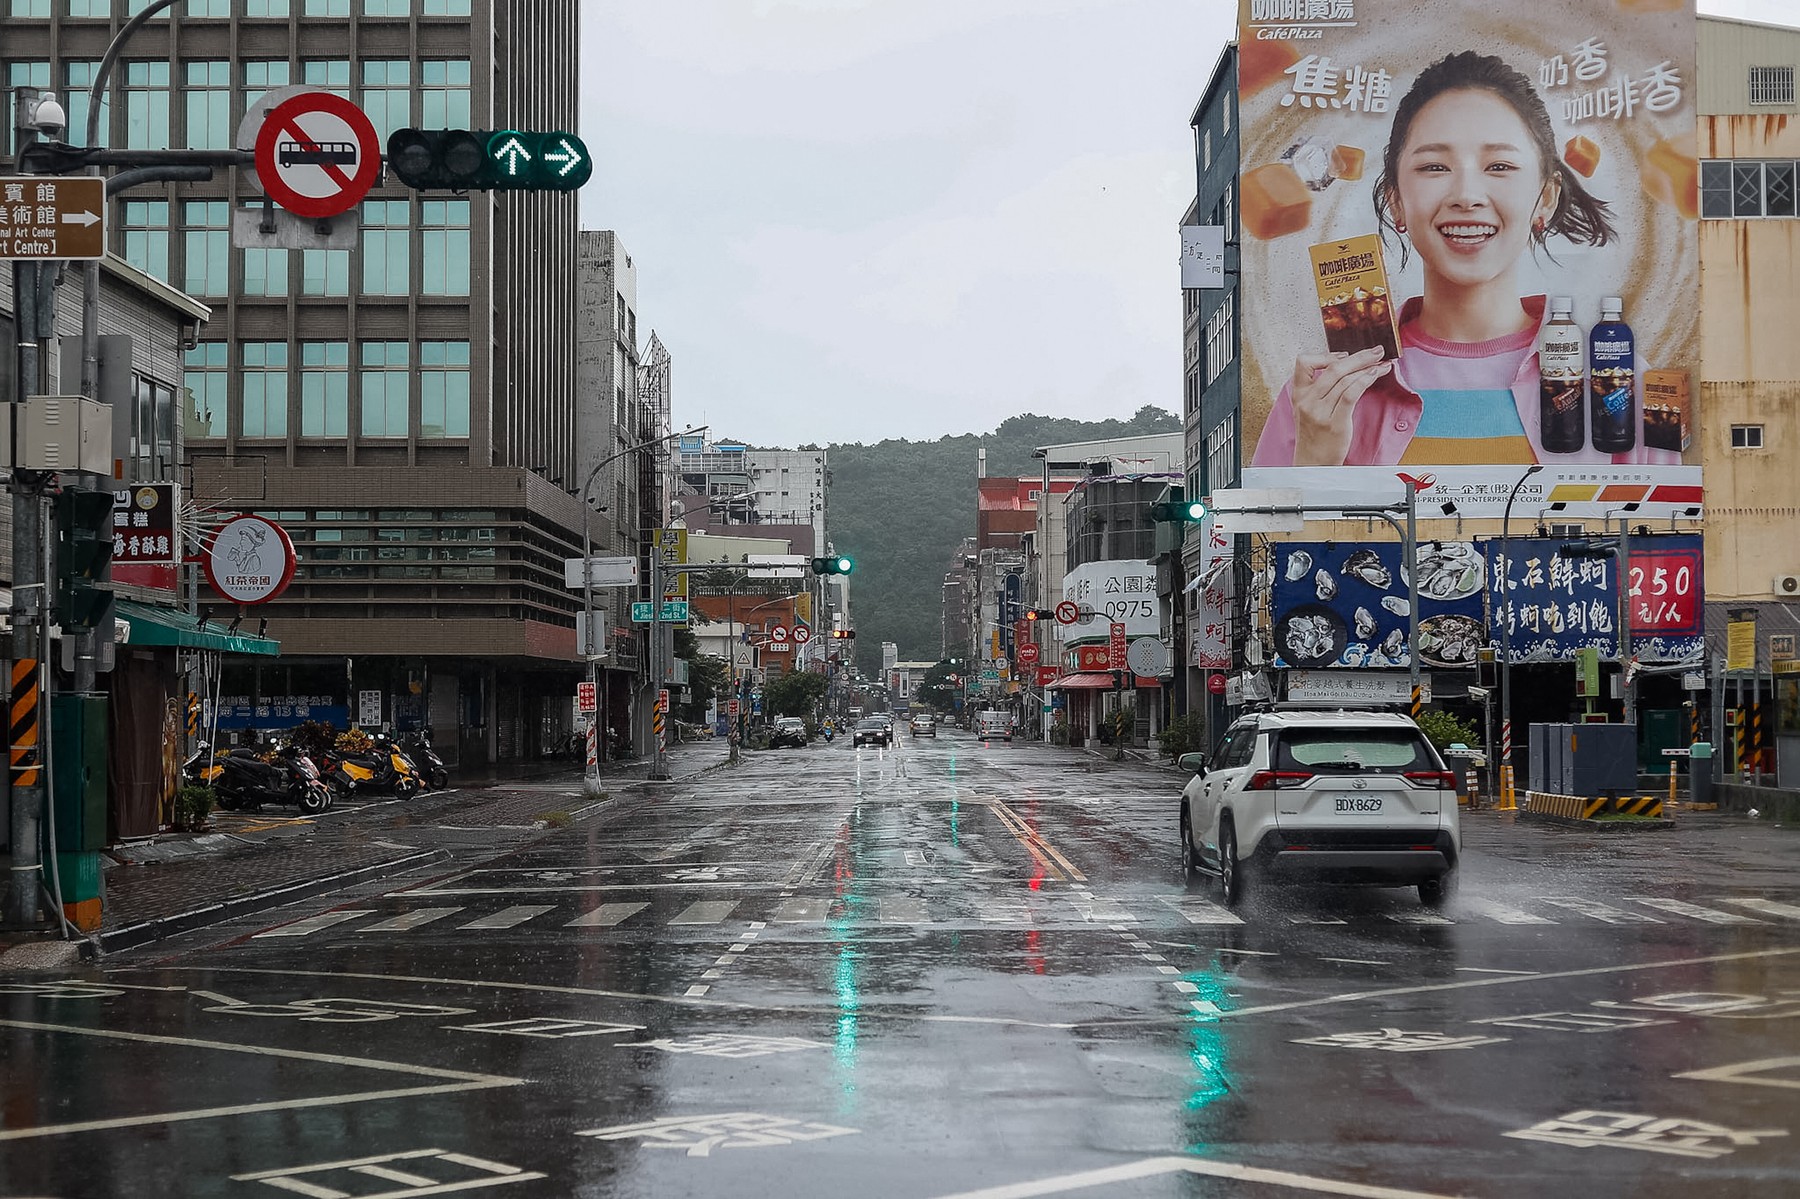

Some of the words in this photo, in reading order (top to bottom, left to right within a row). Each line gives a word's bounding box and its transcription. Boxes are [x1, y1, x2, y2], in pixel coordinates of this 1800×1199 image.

[1250, 0, 1354, 21] 咖啡廣場
[1538, 36, 1608, 90] 奶香
[1280, 54, 1393, 113] 焦糖
[1562, 60, 1681, 125] 咖啡香
[15, 227, 28, 238] Art
[32, 227, 56, 238] Center
[1318, 252, 1375, 277] 咖啡廣場
[114, 512, 148, 527] 蛋糕
[1493, 552, 1607, 596] 東石鮮蚵
[1628, 565, 1690, 597] 250
[661, 611, 672, 619] 2nd
[1105, 600, 1153, 618] 0975
[1495, 598, 1612, 636] 烤蚵吃到飽
[1335, 798, 1382, 812] BDX-8629
